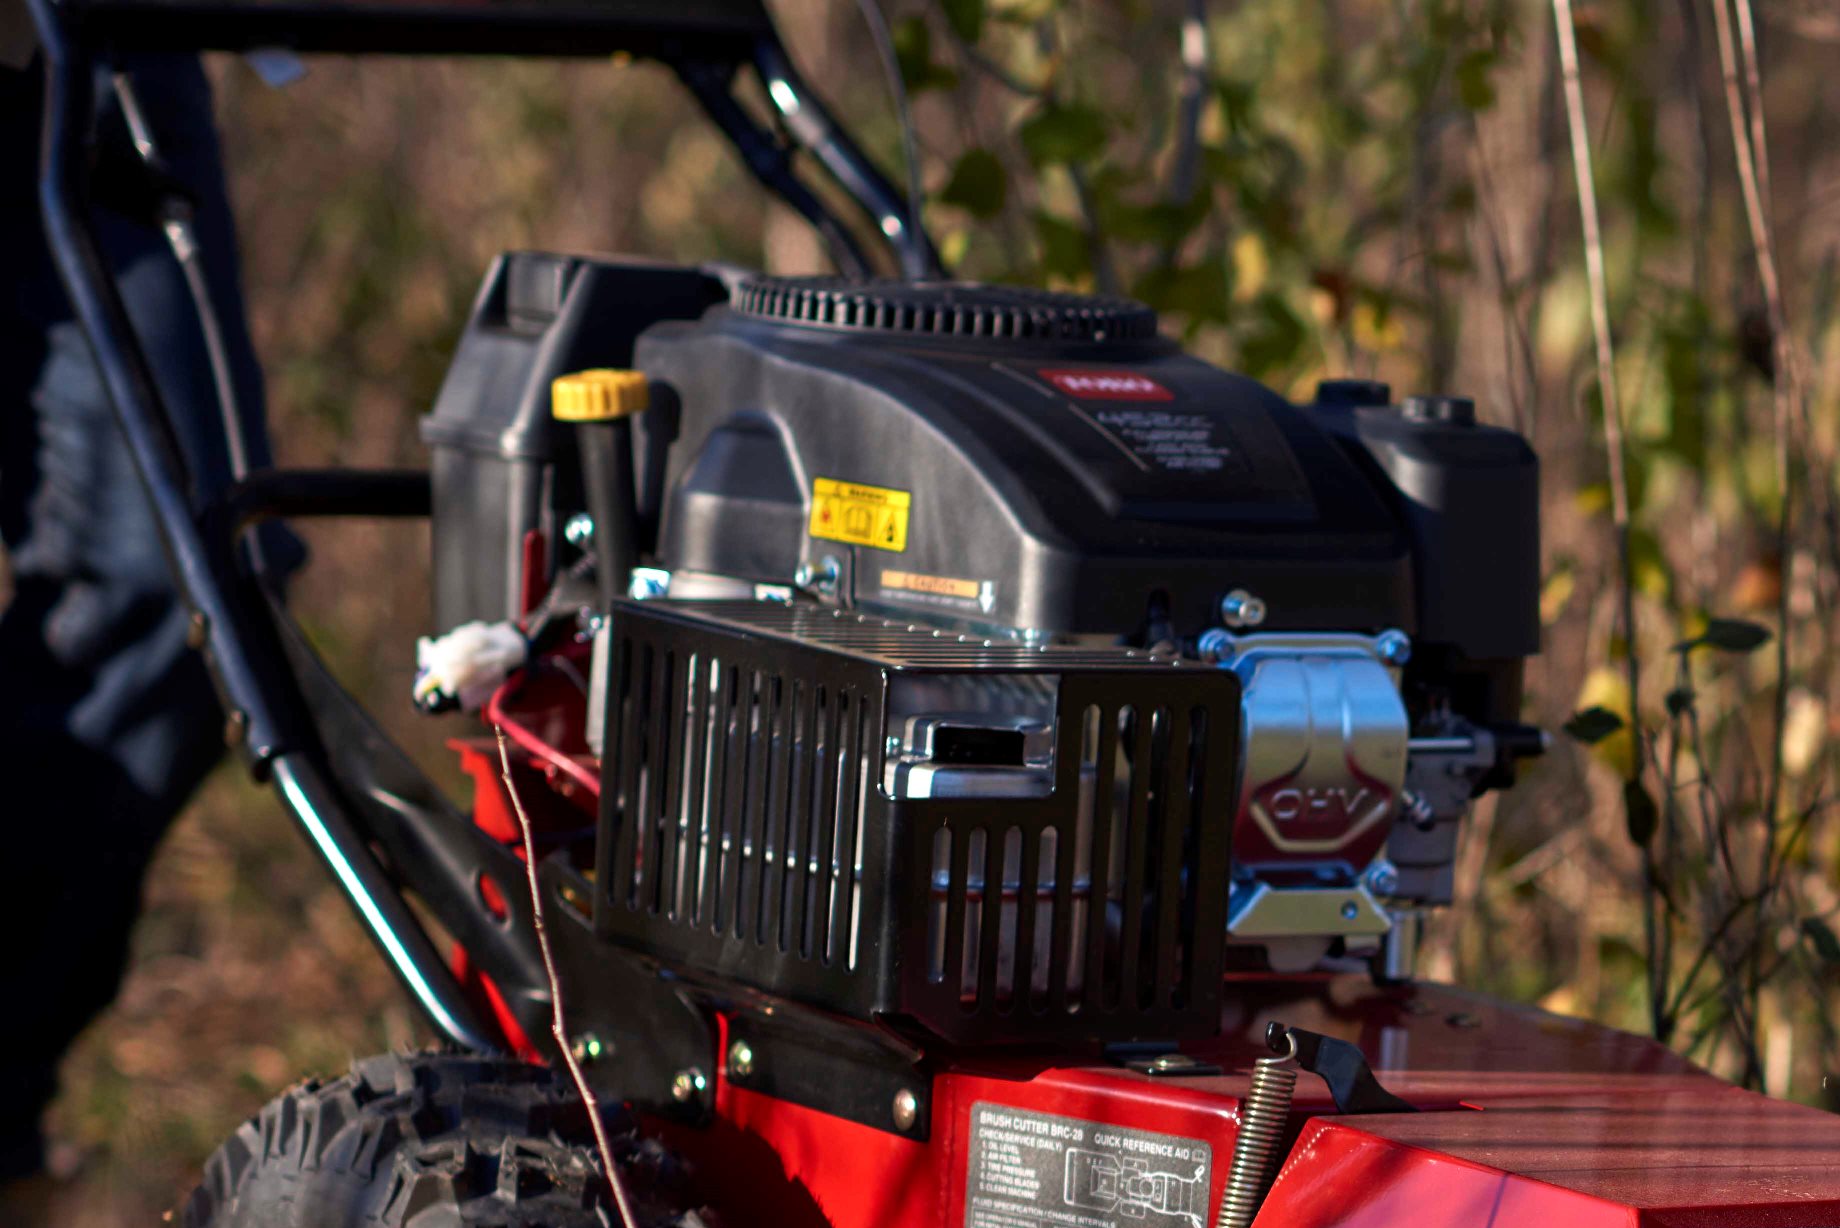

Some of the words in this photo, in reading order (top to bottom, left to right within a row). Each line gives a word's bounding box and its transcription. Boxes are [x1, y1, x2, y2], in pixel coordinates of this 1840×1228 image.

[1272, 788, 1371, 819] OHV
[980, 1111, 1012, 1128] BRUSH
[1013, 1117, 1049, 1135] CUTTER
[1050, 1123, 1083, 1141] BRC-28
[1000, 1143, 1020, 1155] LEVEL
[1094, 1132, 1121, 1146] QUICK
[1122, 1137, 1173, 1158] REFERENCE
[1174, 1147, 1190, 1161] AID
[1000, 1154, 1021, 1166] FILTER
[986, 1172, 1013, 1185] CUTTING
[1014, 1177, 1040, 1190] BLADES
[994, 1200, 1043, 1217] SPECIFICATION
[1048, 1211, 1077, 1224] CHANGE
